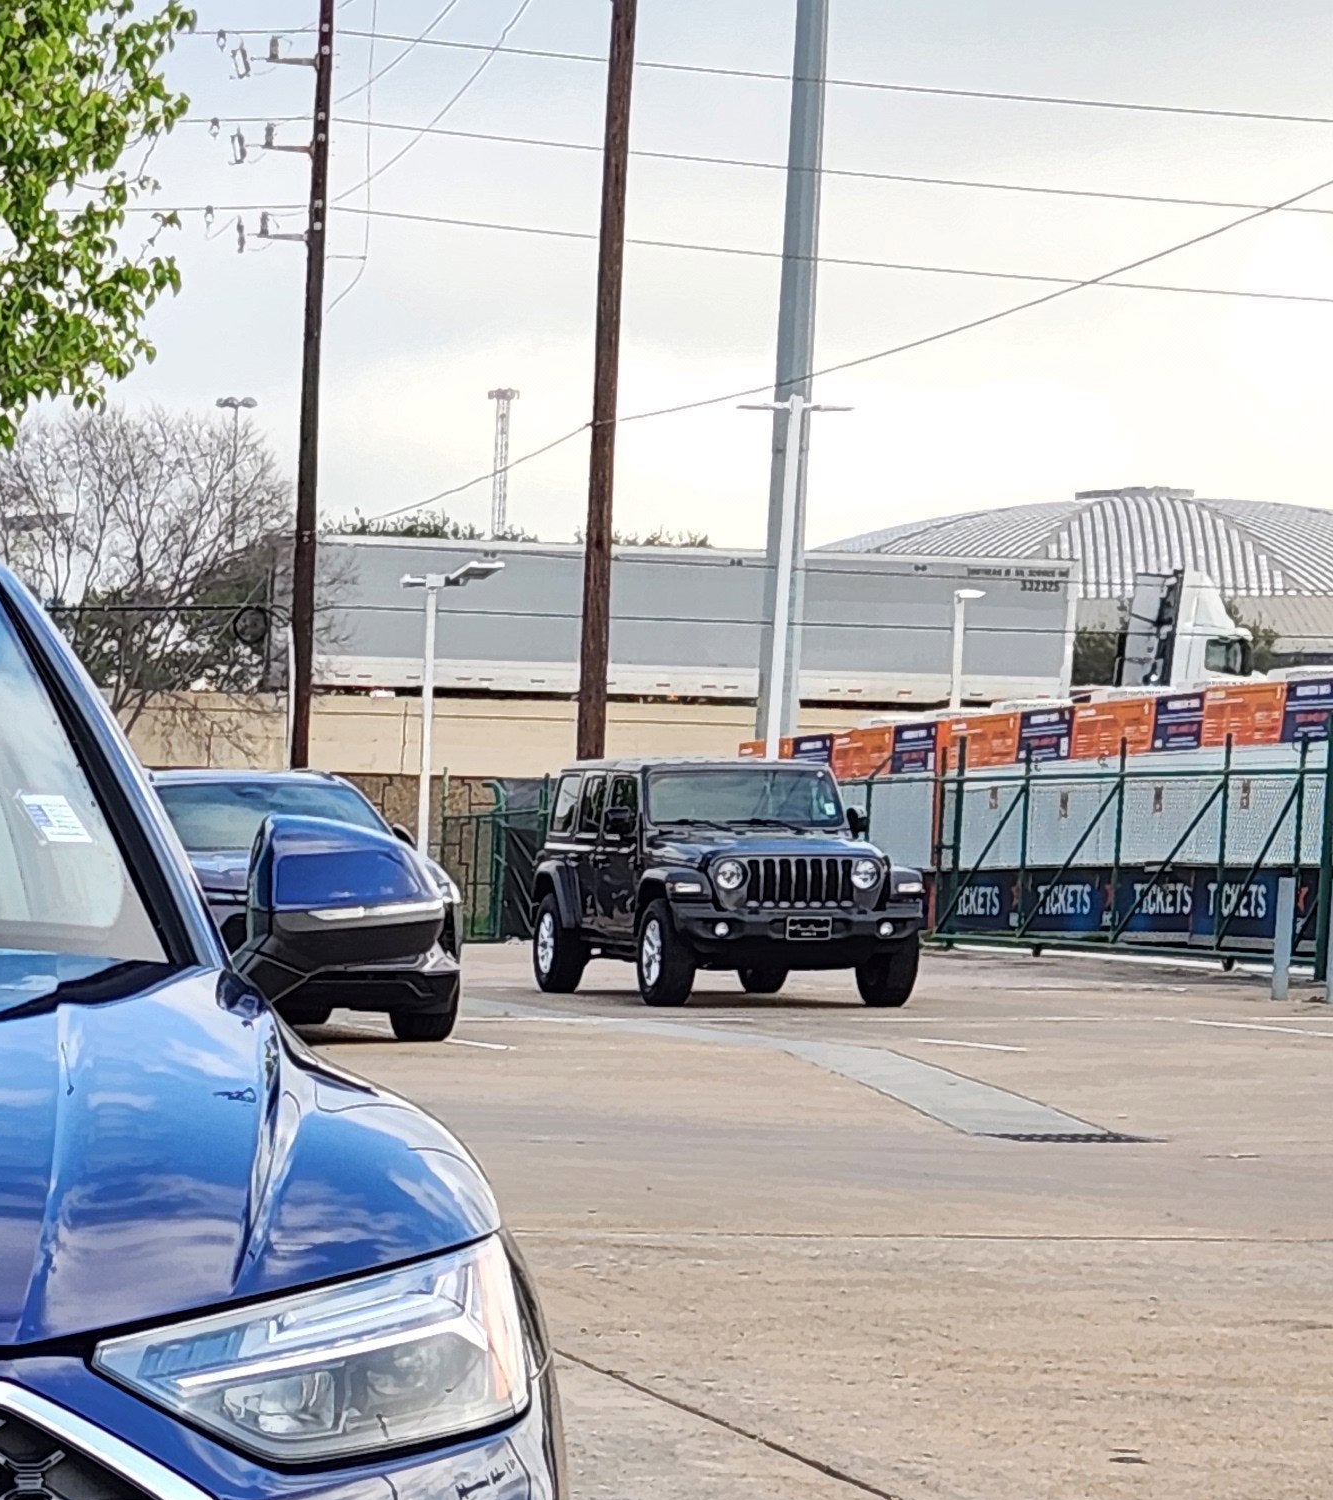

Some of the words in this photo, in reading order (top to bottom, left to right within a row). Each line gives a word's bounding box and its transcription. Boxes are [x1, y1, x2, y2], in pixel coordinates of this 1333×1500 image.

[1037, 883, 1092, 915] TICKETS
[1133, 882, 1193, 915] TICKETS
[1207, 882, 1267, 918] TCKETS
